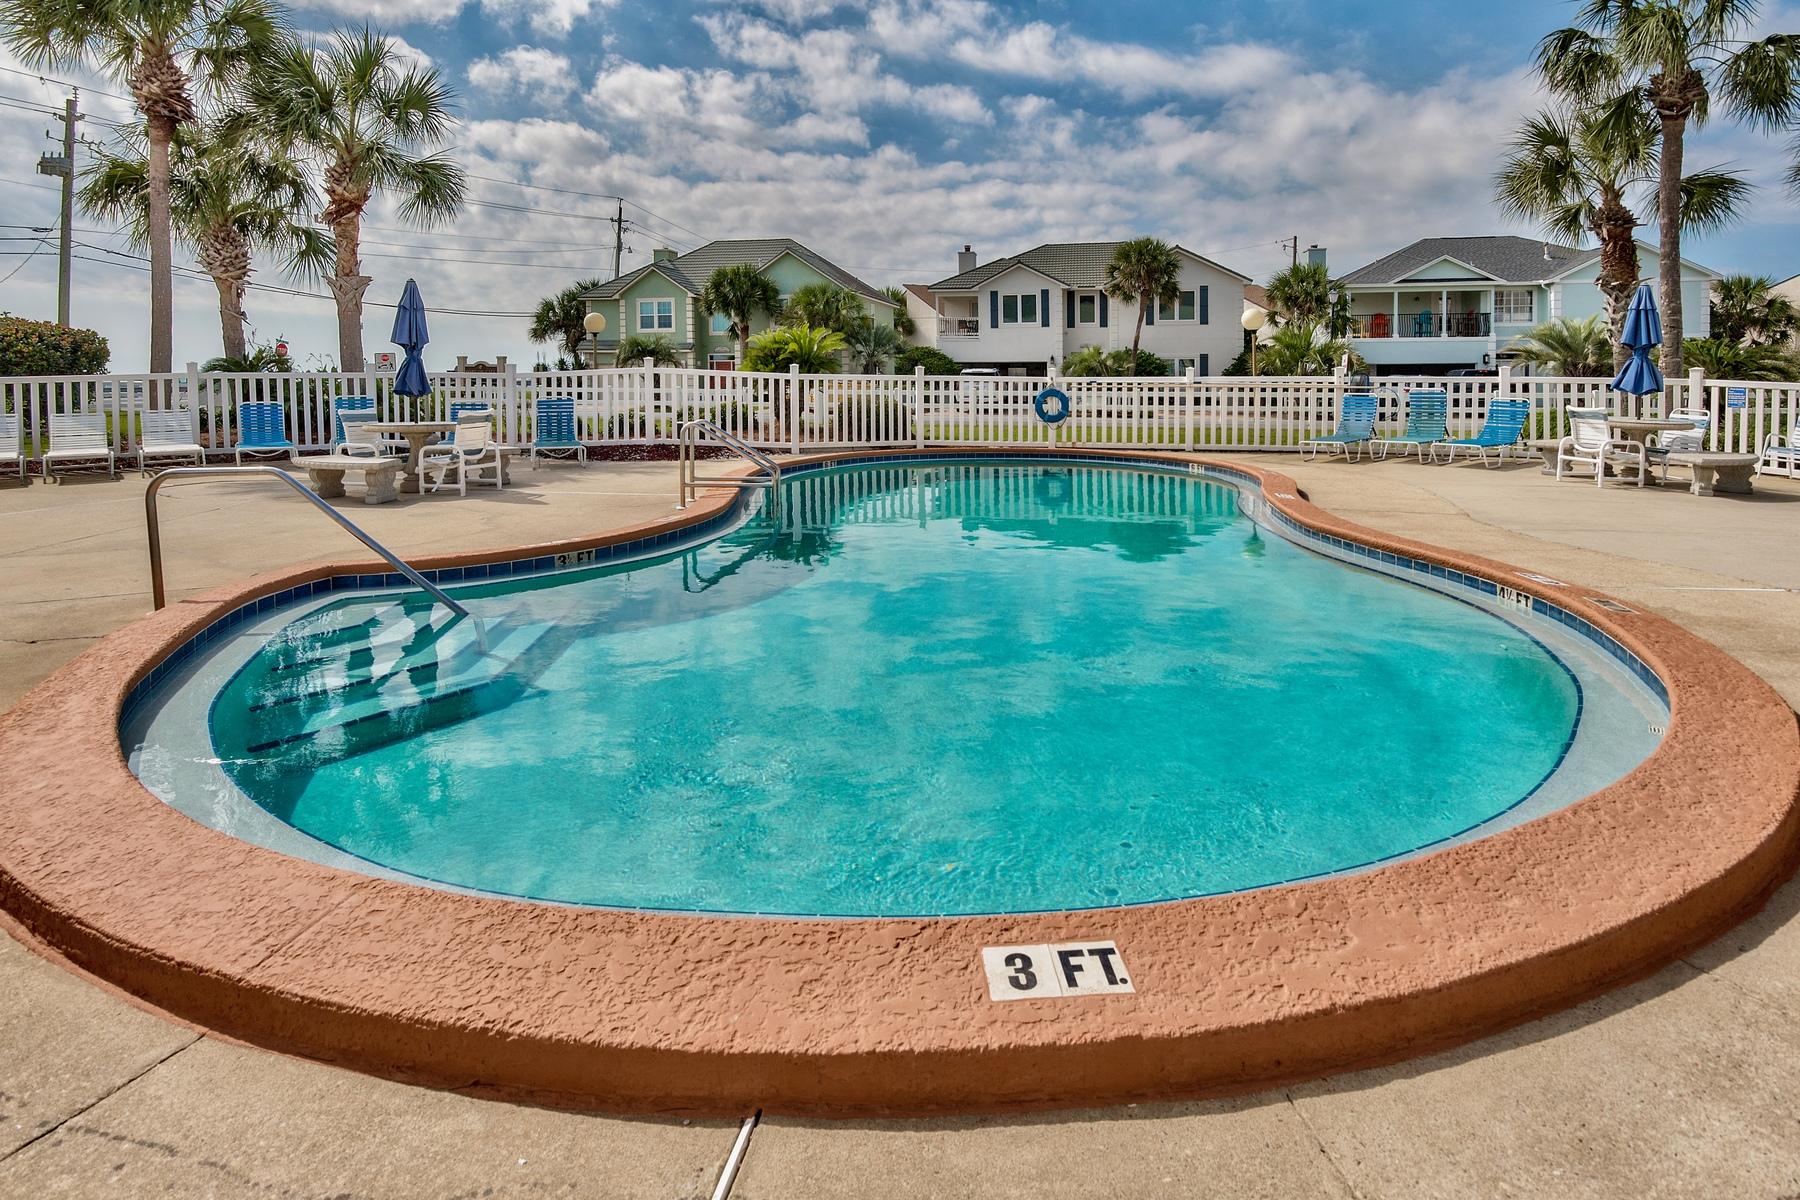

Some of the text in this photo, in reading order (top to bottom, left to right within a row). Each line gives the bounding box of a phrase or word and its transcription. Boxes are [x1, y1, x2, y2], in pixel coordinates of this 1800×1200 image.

[577, 550, 593, 563] FT
[1516, 592, 1530, 608] FT
[1004, 948, 1129, 990] 3 FT.
